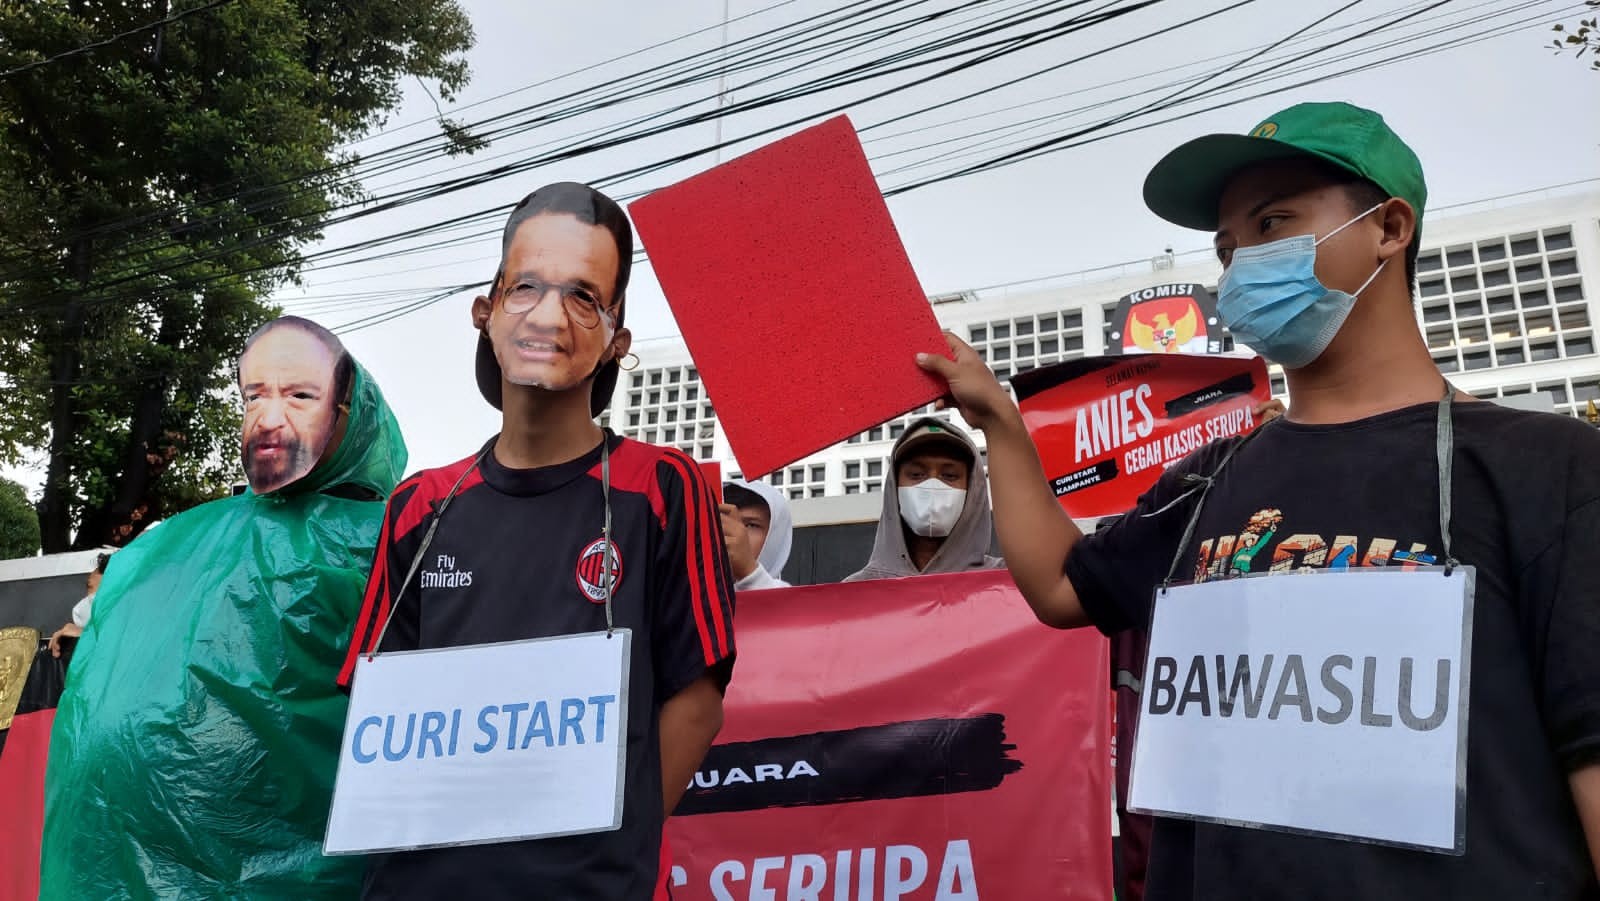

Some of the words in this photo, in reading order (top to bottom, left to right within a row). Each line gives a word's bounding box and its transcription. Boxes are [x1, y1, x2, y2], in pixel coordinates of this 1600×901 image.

[1129, 284, 1194, 304] KOMISI
[1194, 390, 1223, 404] JUARA
[1075, 383, 1154, 463] ANIES
[1124, 440, 1162, 475] CEGAH
[1164, 424, 1203, 460] KASUS
[1205, 405, 1254, 444] SERUPA
[1055, 476, 1074, 486] CURI
[1073, 466, 1098, 480] START
[1056, 474, 1101, 495] KAMPANYE
[437, 554, 455, 572] Fly
[421, 570, 473, 588] Emirates
[1148, 653, 1452, 732] BAWASLU
[351, 708, 462, 764] CURI
[473, 694, 616, 754] START
